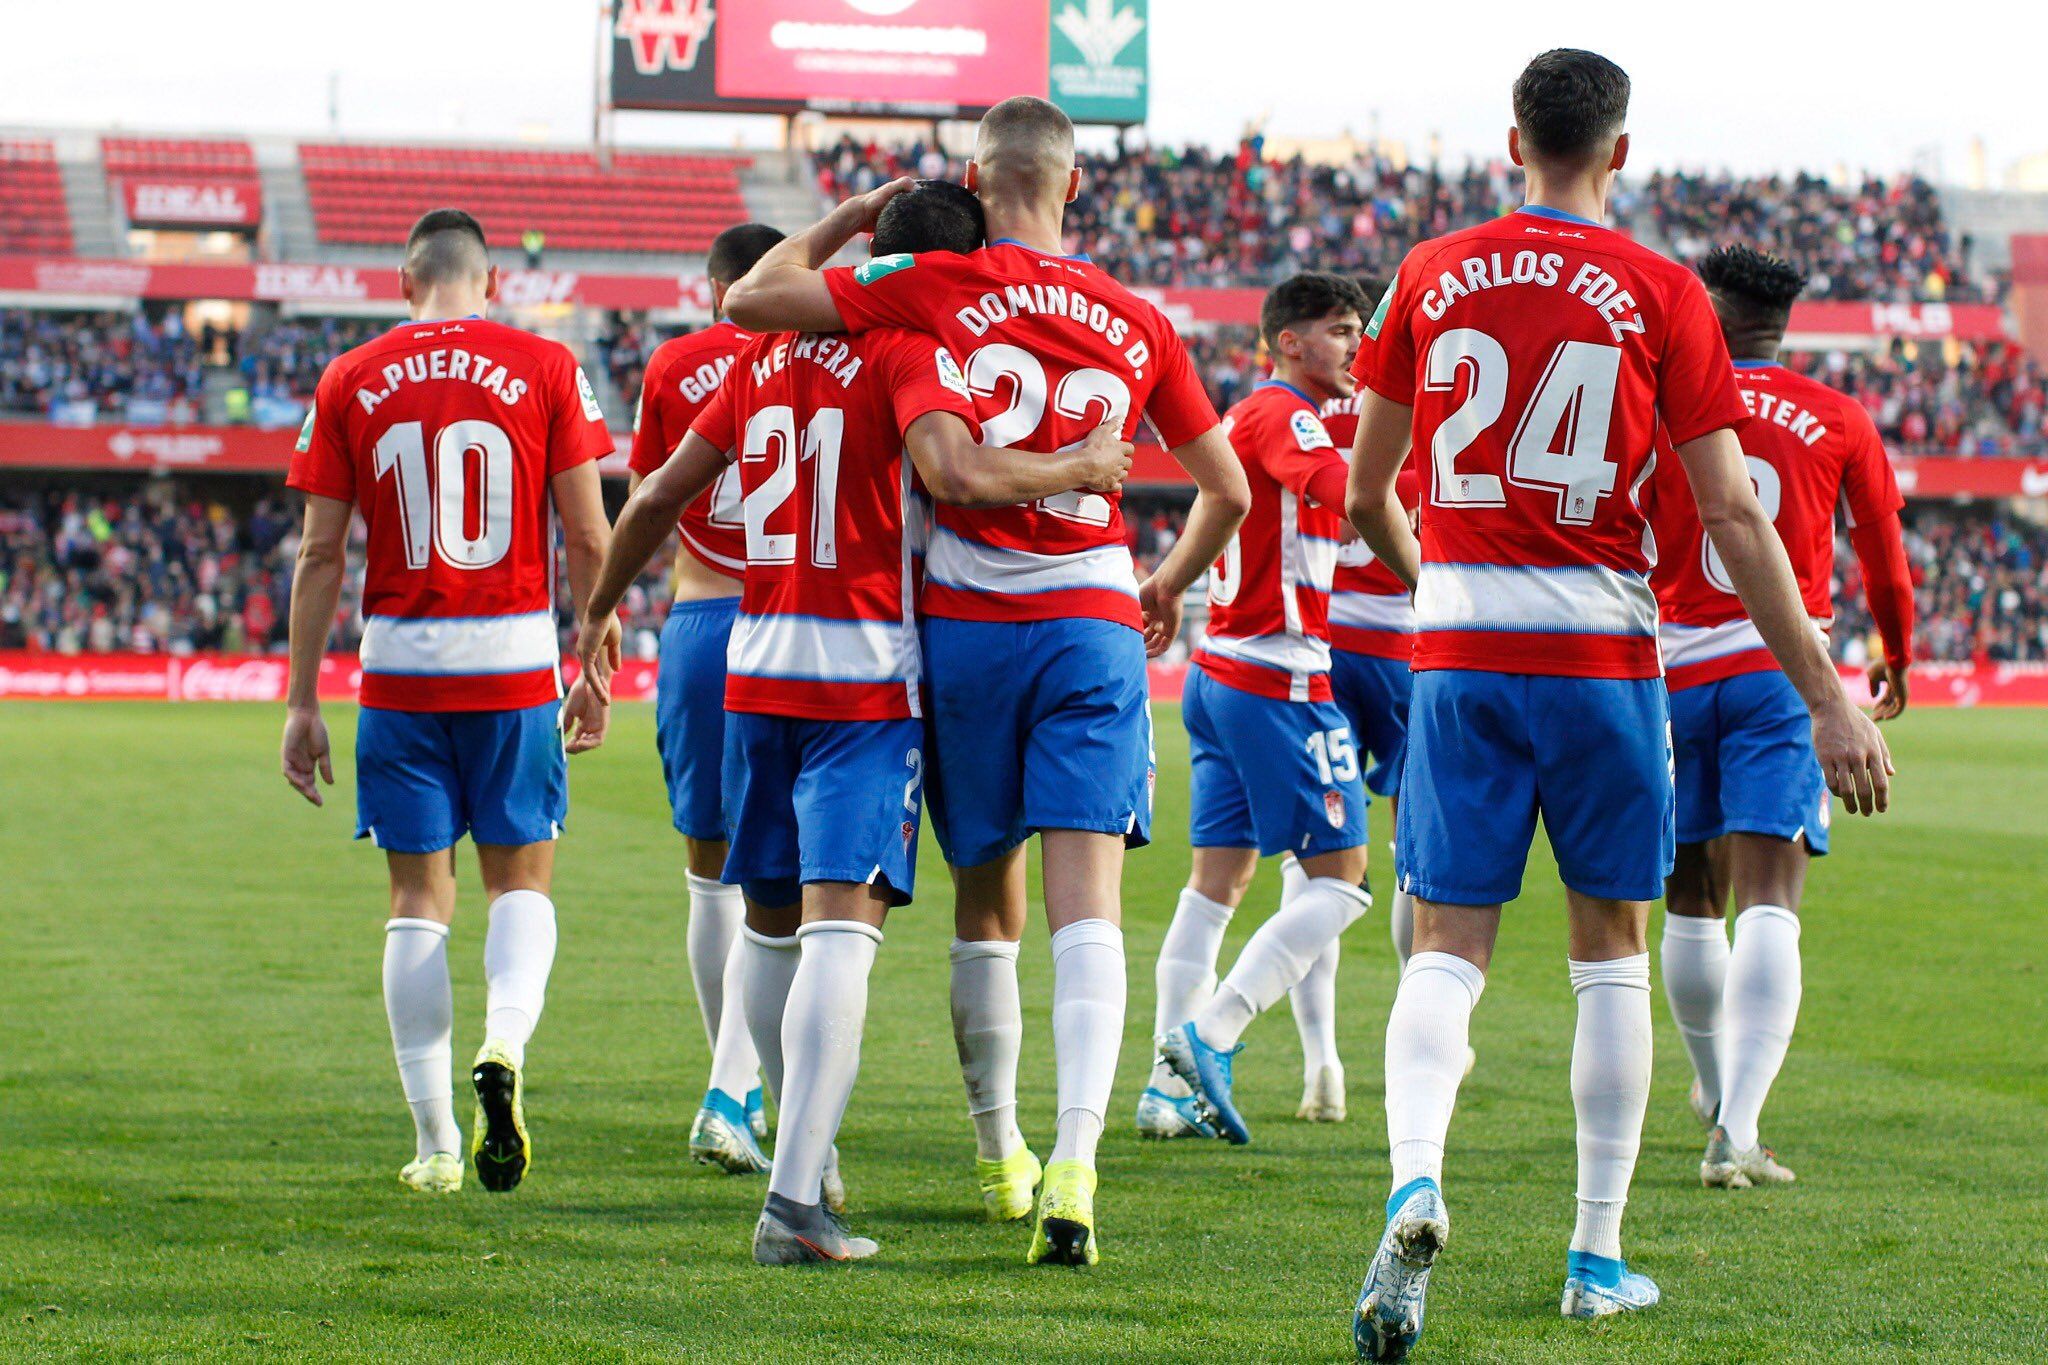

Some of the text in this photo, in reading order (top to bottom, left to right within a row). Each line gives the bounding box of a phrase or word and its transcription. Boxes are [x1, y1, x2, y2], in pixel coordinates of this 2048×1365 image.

[135, 183, 248, 221] IDEAL
[254, 265, 369, 299] IDEAL
[1421, 250, 1647, 343] CARLOS FDEZ
[956, 284, 1129, 347] DOMINGOS
[1123, 339, 1149, 381] D.
[356, 348, 528, 416] A.PUERTAS
[1424, 327, 1623, 527] 24
[372, 418, 513, 571] 10
[741, 404, 845, 570] 21
[1305, 727, 1358, 786] 15
